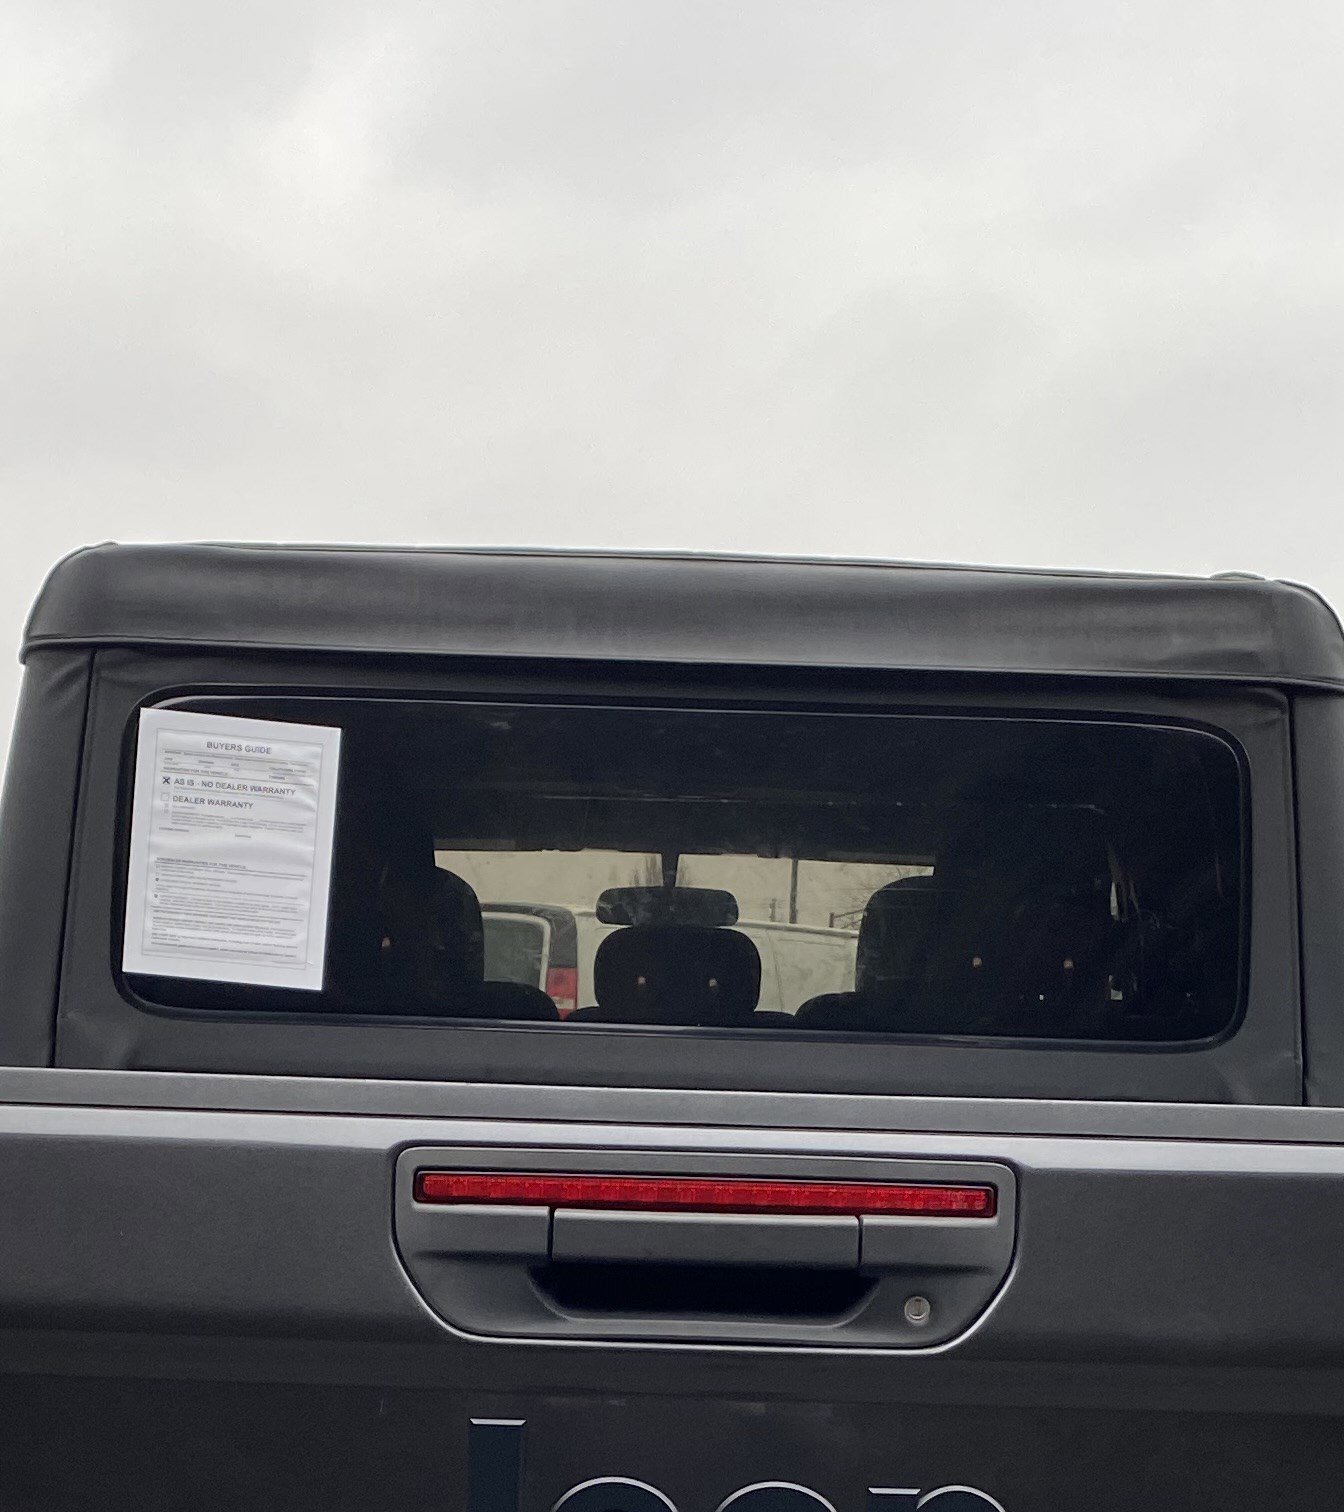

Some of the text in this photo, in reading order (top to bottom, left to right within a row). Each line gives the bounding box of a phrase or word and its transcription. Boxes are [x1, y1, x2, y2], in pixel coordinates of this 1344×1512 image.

[206, 741, 272, 754] BUYERS GUIDE
[201, 780, 213, 788] NO
[216, 782, 248, 791] DEALER
[249, 785, 296, 795] WARRANTY
[173, 795, 254, 809] DEALER WARRANTY
